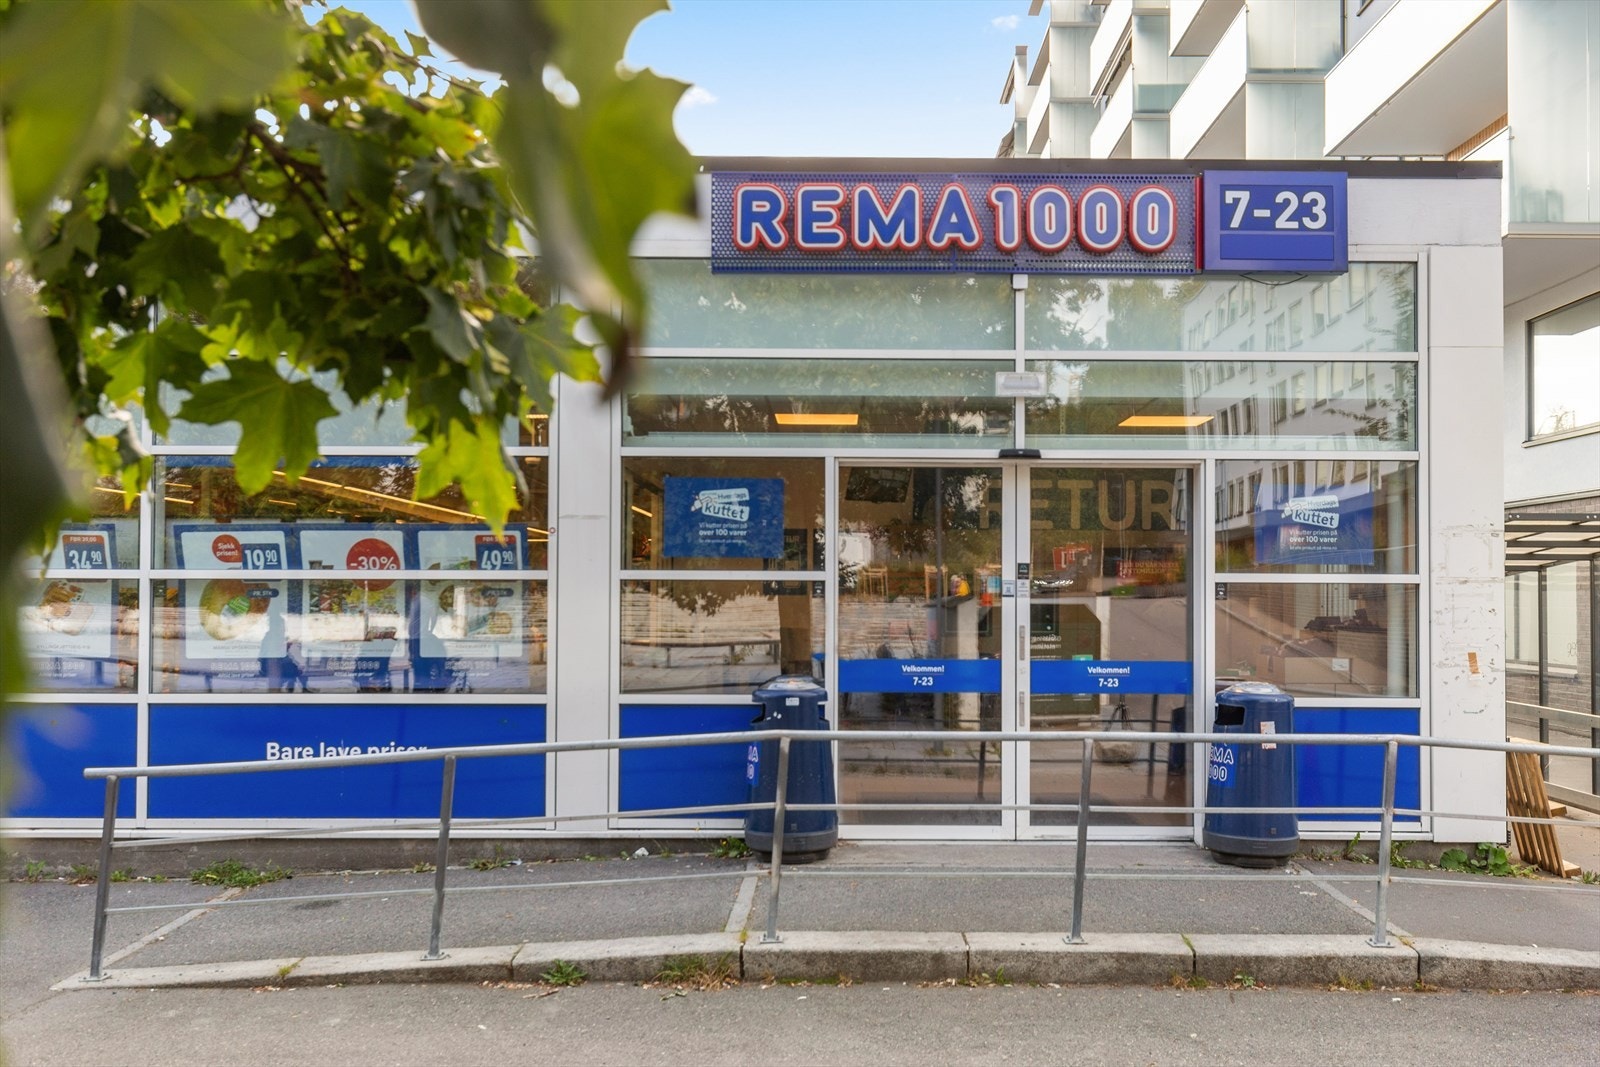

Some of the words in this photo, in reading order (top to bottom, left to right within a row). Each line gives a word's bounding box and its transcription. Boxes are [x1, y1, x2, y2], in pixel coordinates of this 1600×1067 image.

[1225, 190, 1327, 230] 7-23
[733, 182, 983, 252] REMA
[987, 183, 1178, 254] 1000
[704, 503, 745, 520] kuttet
[1295, 509, 1335, 527] kuttet
[218, 542, 235, 550] Sjekk
[350, 556, 397, 570] -30%
[902, 664, 945, 674] Velkommen!
[1087, 666, 1130, 676] Velkommen!
[913, 676, 934, 686] 7-23
[1098, 678, 1119, 688] 7-23
[266, 742, 314, 760] Bare
[319, 742, 361, 758] lave
